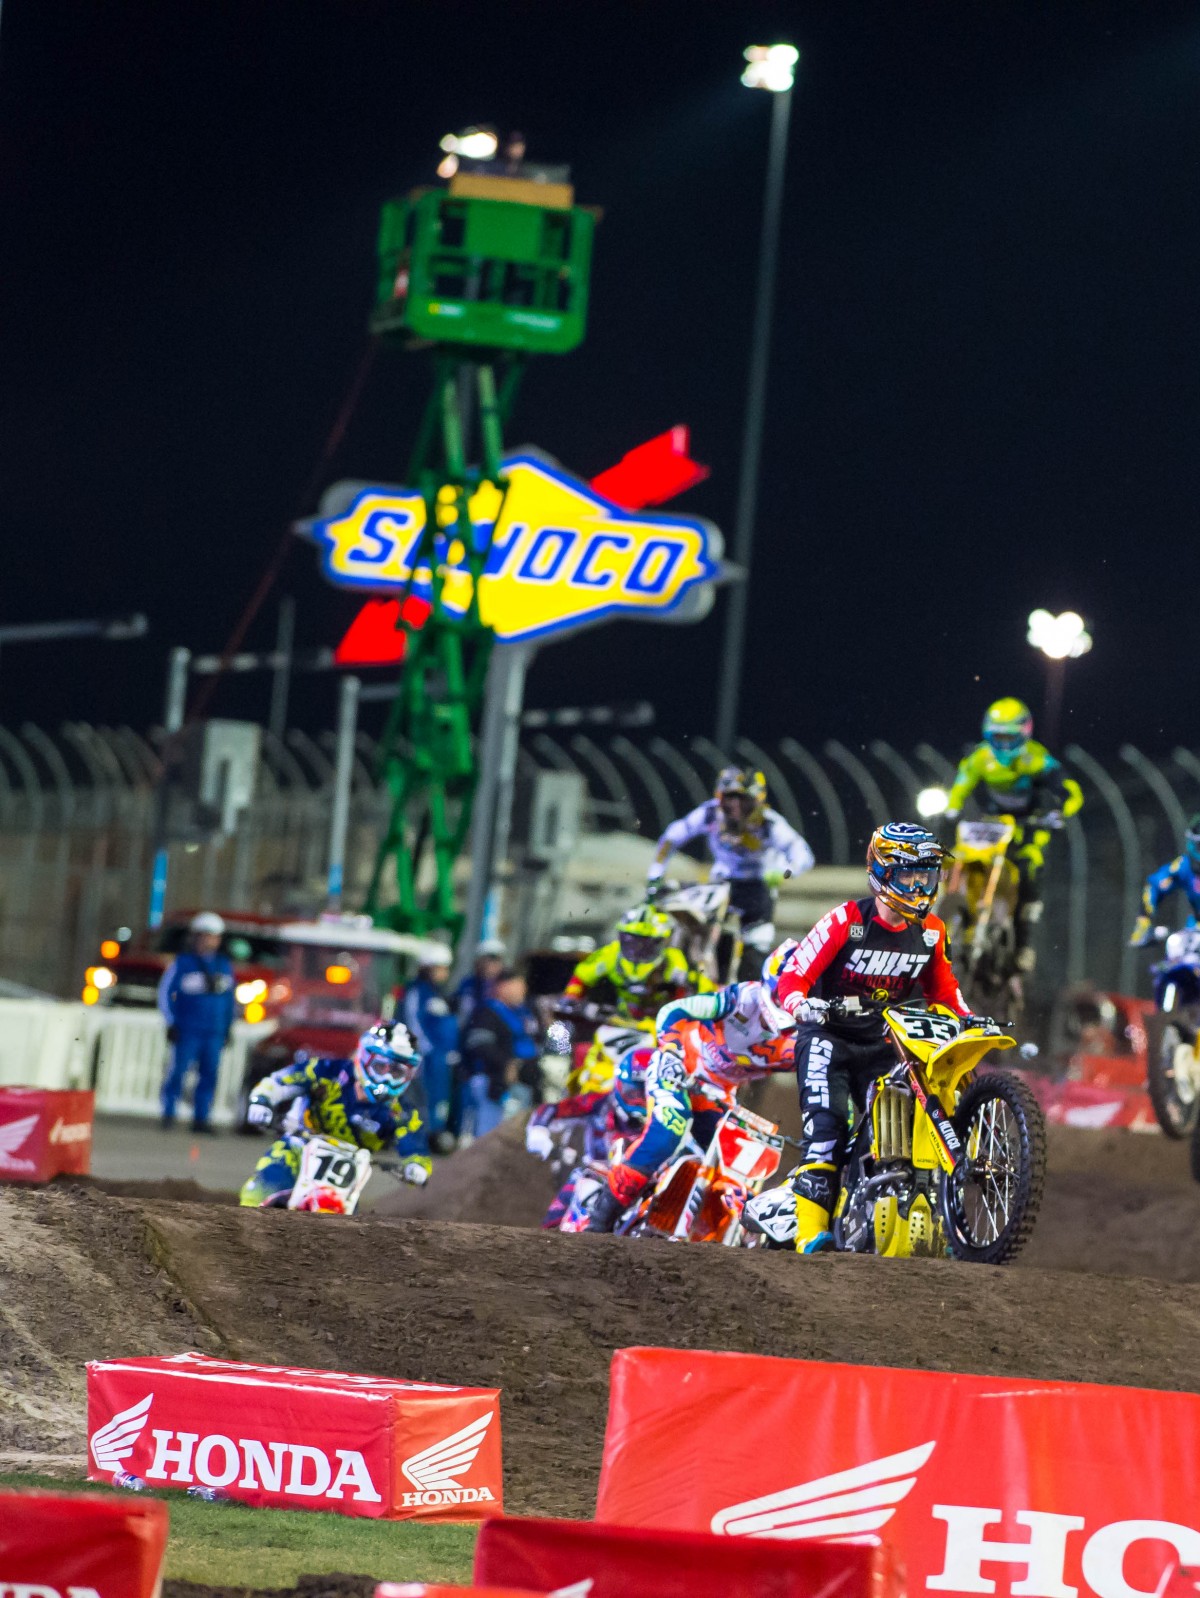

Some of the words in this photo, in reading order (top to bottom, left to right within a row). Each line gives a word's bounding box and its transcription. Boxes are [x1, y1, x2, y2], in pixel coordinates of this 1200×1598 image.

[348, 510, 685, 596] SOCO
[782, 902, 848, 977] SHIFT
[845, 948, 931, 978] SHIFT
[904, 1017, 957, 1041] 33
[805, 1036, 833, 1110] SHIFT
[314, 1154, 357, 1189] 19
[731, 1137, 769, 1179] 1
[146, 1429, 382, 1503] HONDA
[401, 1487, 496, 1508] HONDA
